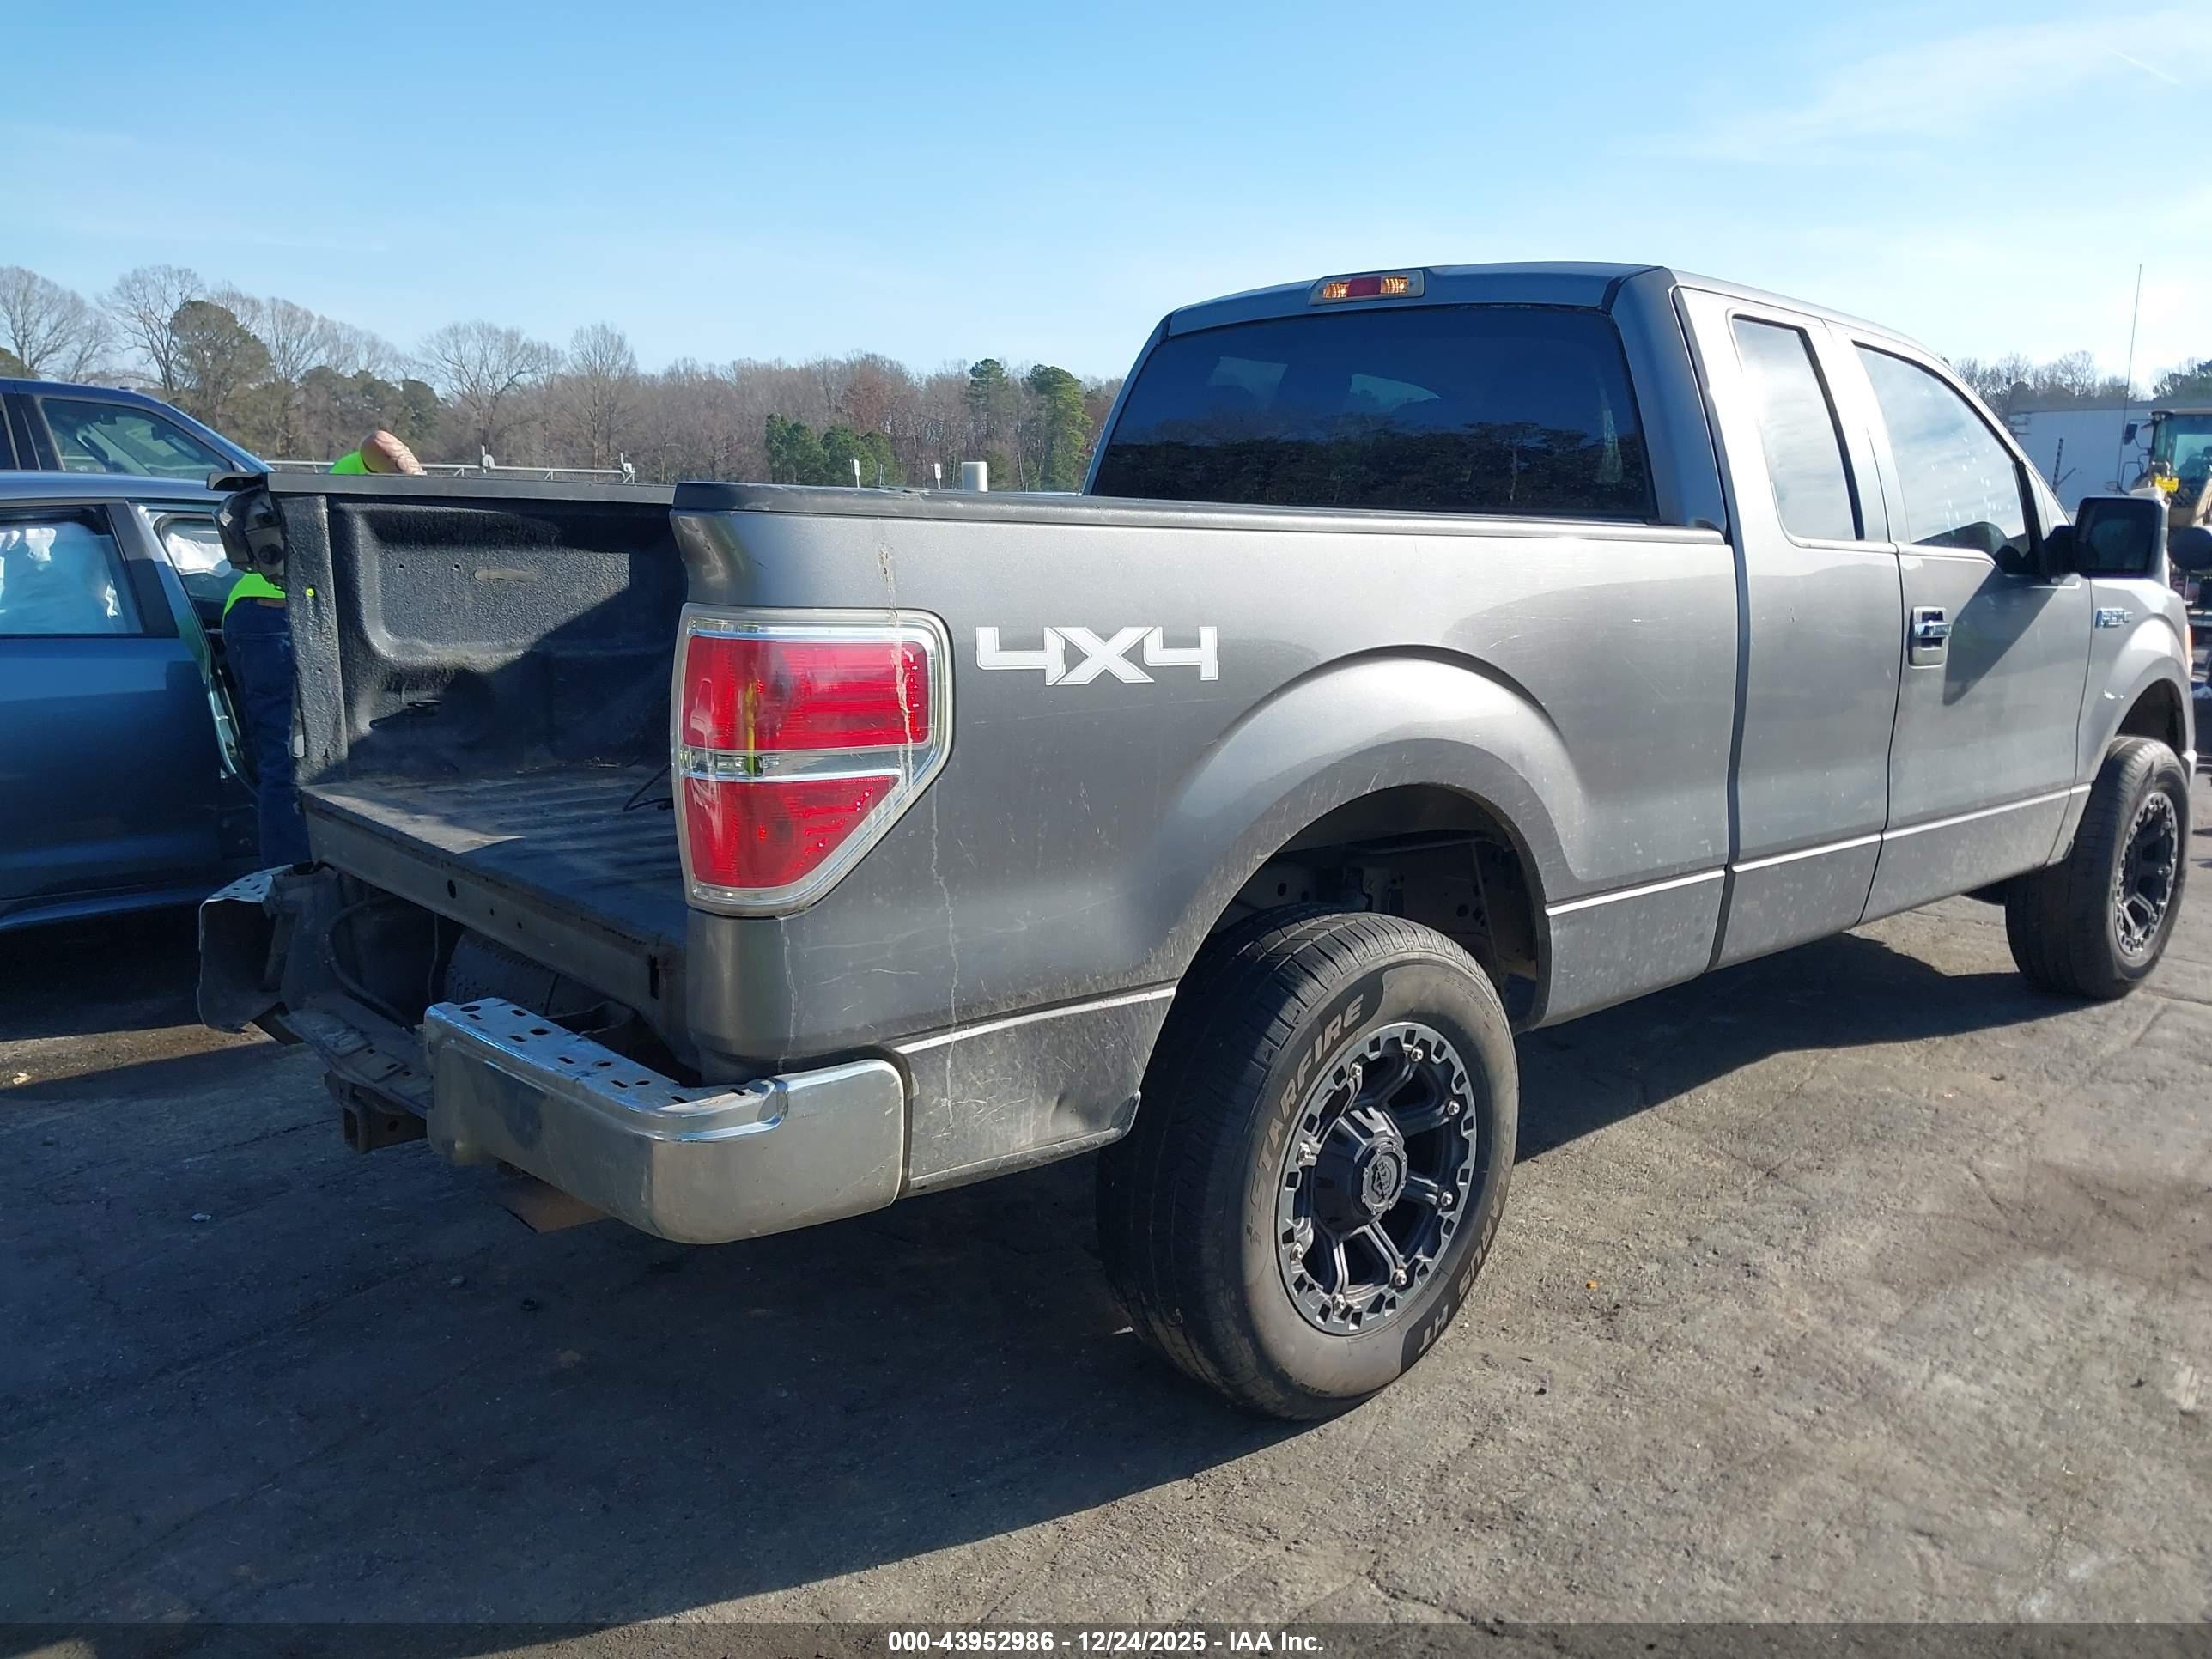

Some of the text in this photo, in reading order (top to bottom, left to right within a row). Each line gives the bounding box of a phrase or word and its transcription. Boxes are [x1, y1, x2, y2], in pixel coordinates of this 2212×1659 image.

[975, 626, 1218, 685] 4X4
[1250, 994, 1364, 1212] STARFIRE
[1419, 1304, 1449, 1355] HT
